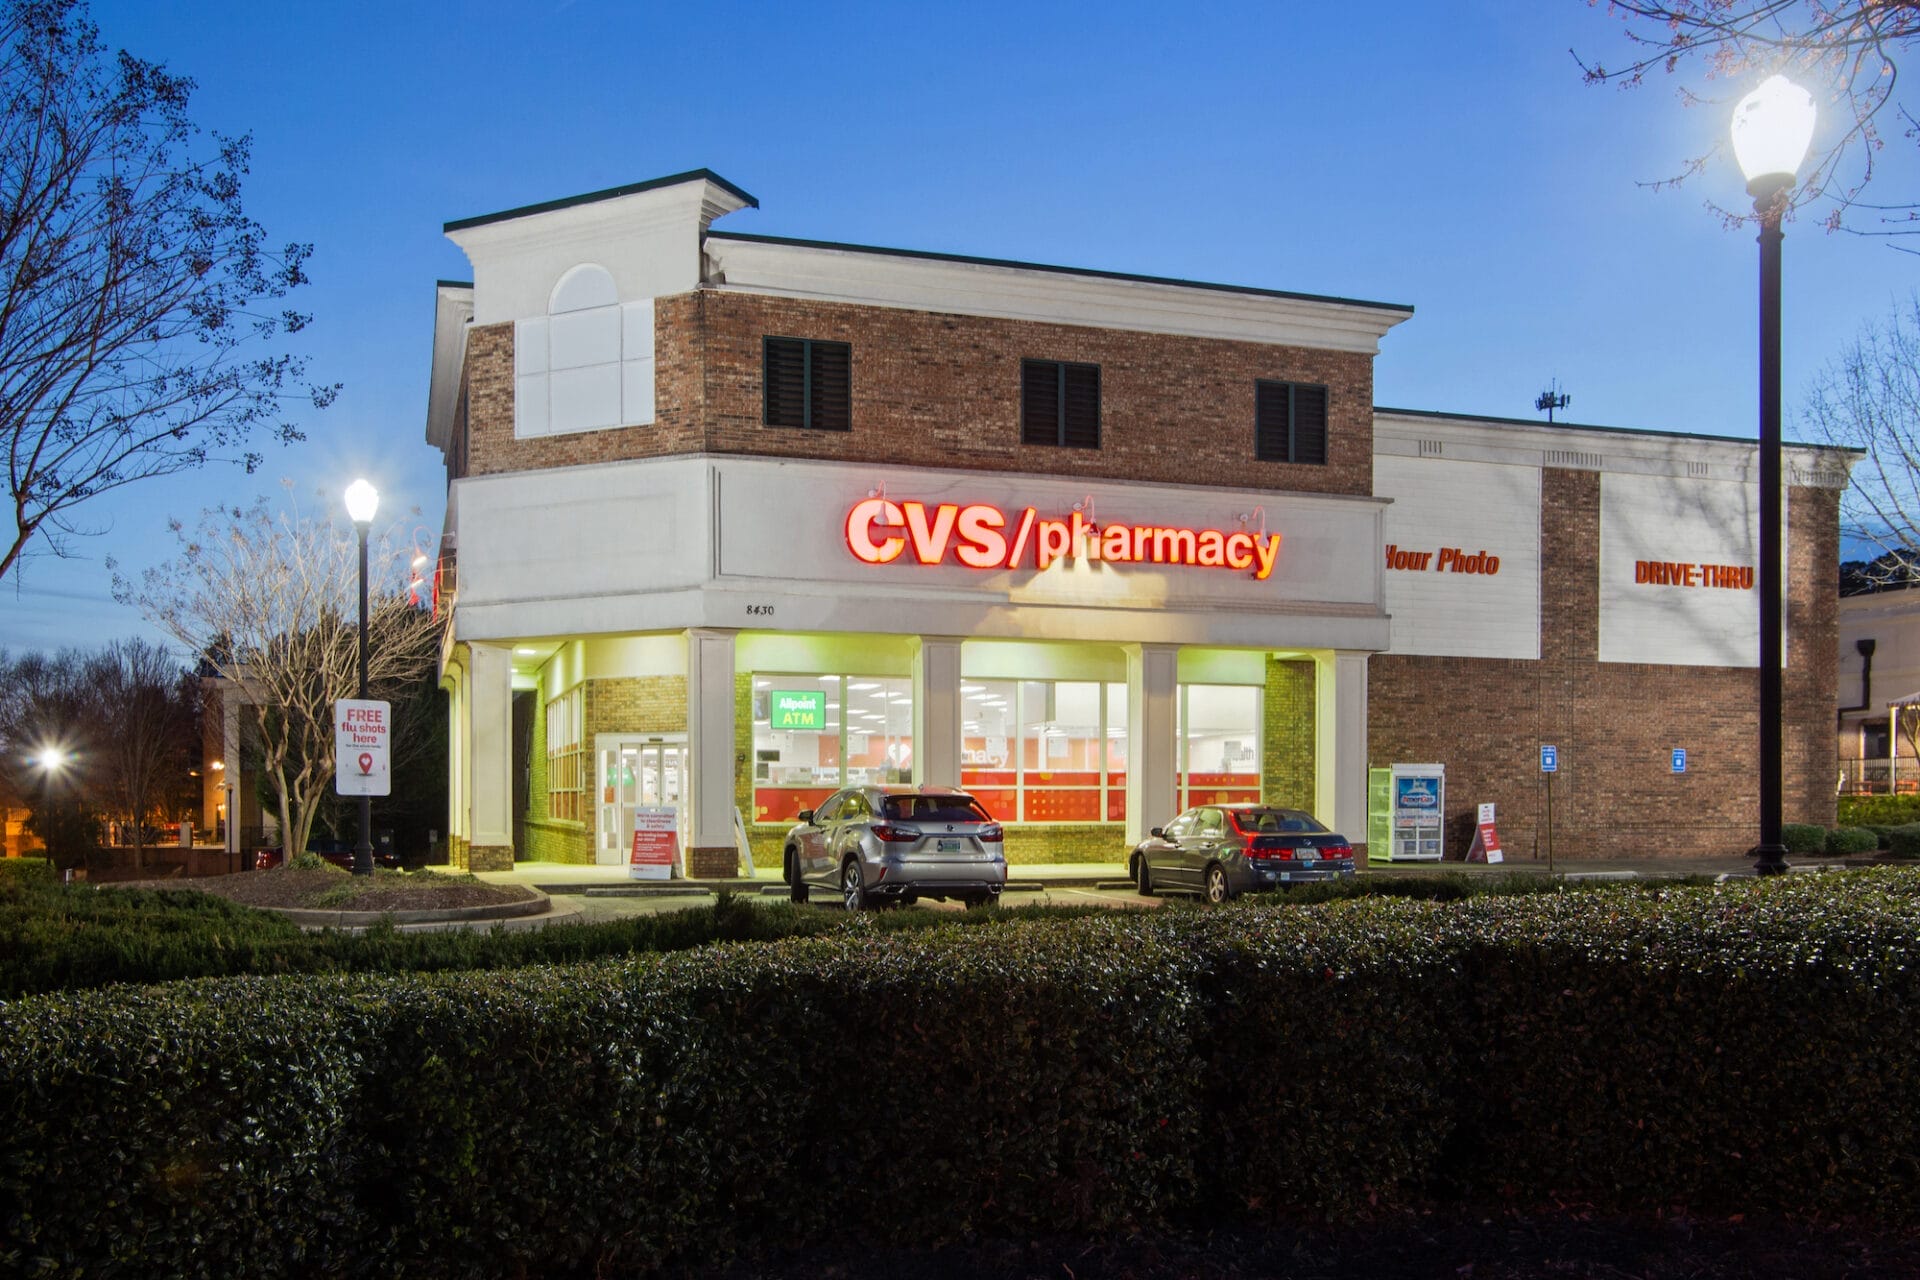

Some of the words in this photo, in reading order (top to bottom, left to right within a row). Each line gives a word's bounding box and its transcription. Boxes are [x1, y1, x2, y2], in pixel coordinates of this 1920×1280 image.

[1436, 547, 1500, 575] Photo
[1635, 560, 1754, 590] DRIVE-THRU
[746, 605, 775, 616] 8430
[779, 696, 816, 711] Allpoint
[347, 709, 382, 723] FREE
[783, 712, 814, 725] ATM
[341, 722, 357, 732] flu
[359, 723, 386, 733] shots
[353, 733, 377, 743] here
